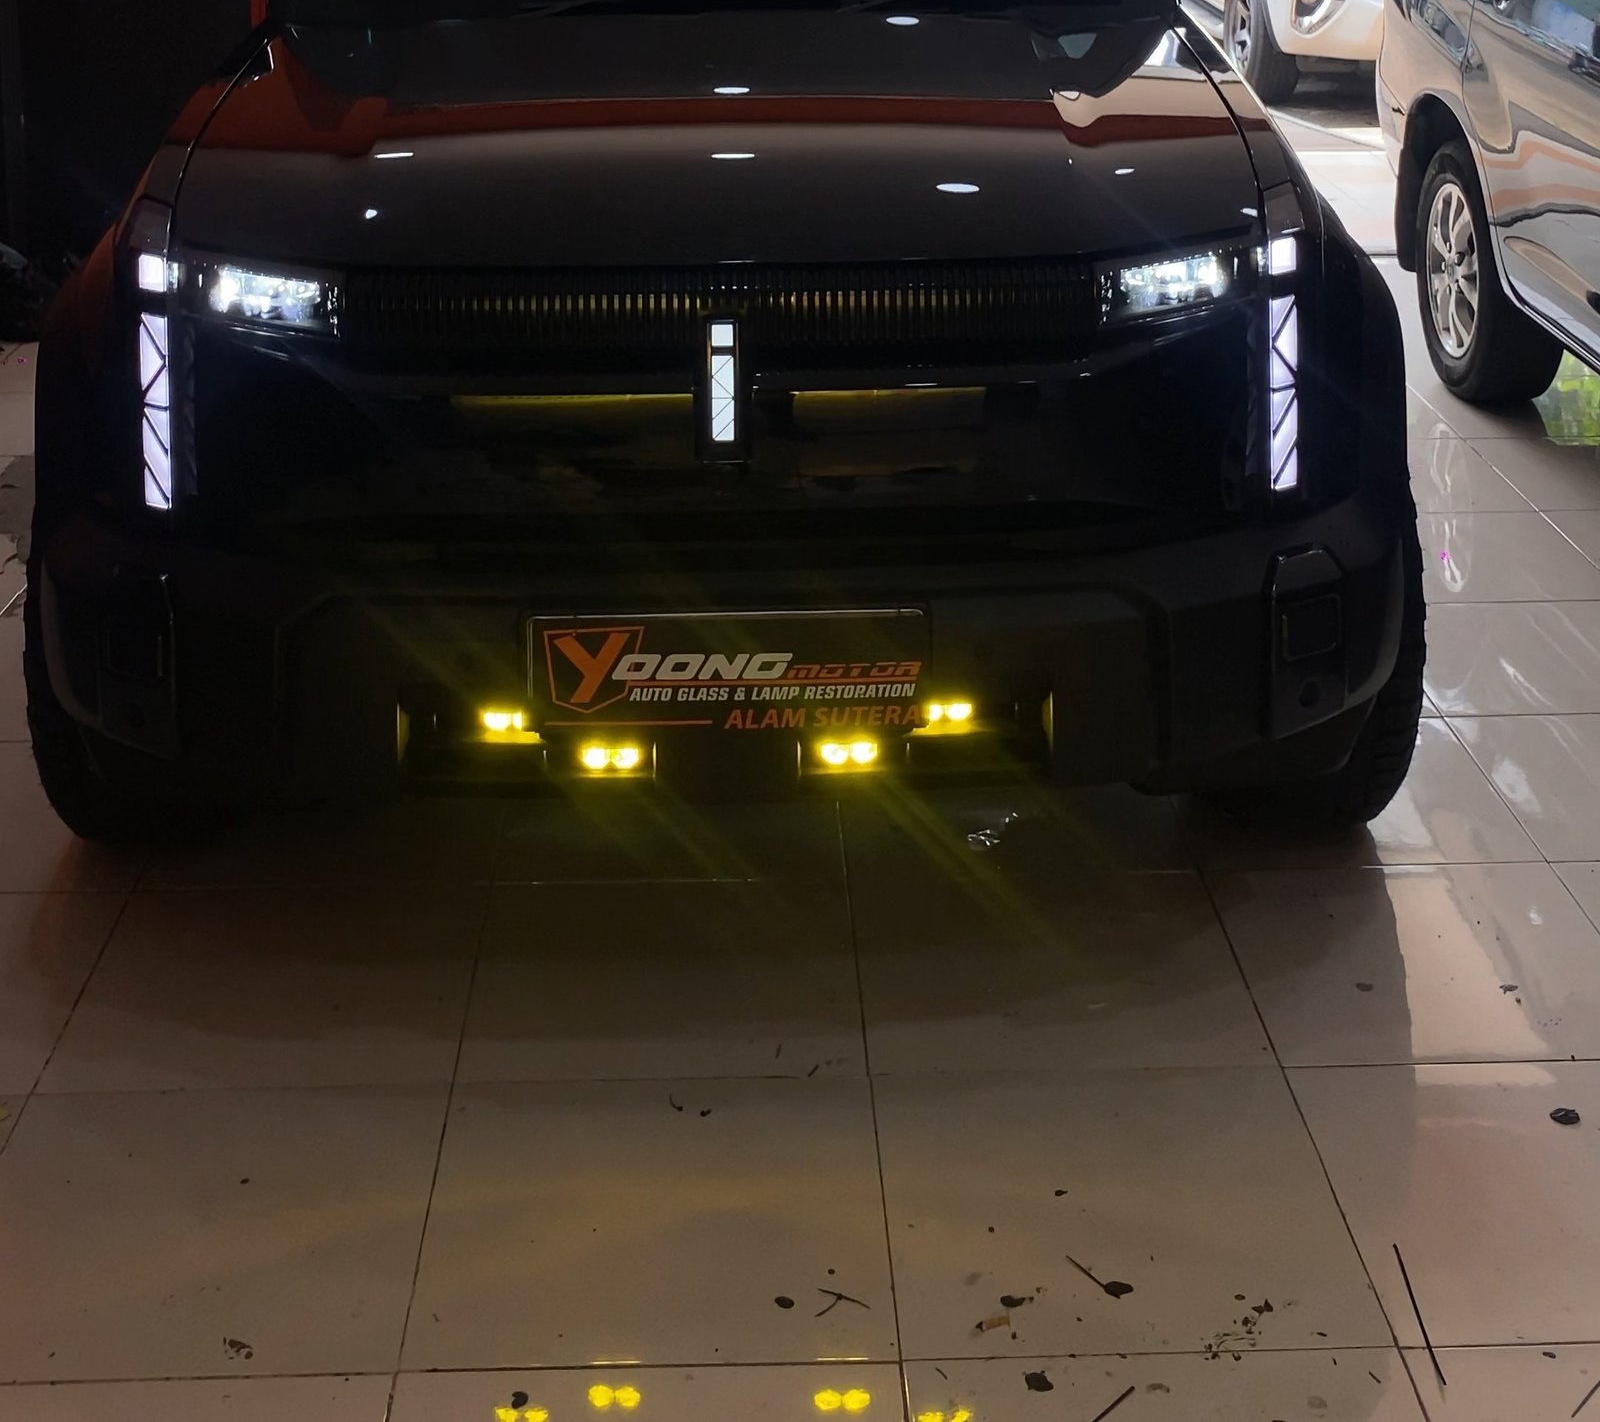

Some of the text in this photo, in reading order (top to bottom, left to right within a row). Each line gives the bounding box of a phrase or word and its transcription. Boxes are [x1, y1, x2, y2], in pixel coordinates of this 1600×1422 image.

[553, 632, 793, 703] YOONG
[629, 683, 916, 702] AUTO GLASS & LAMP RESTORATION
[724, 704, 922, 729] ALAM SUTERA
